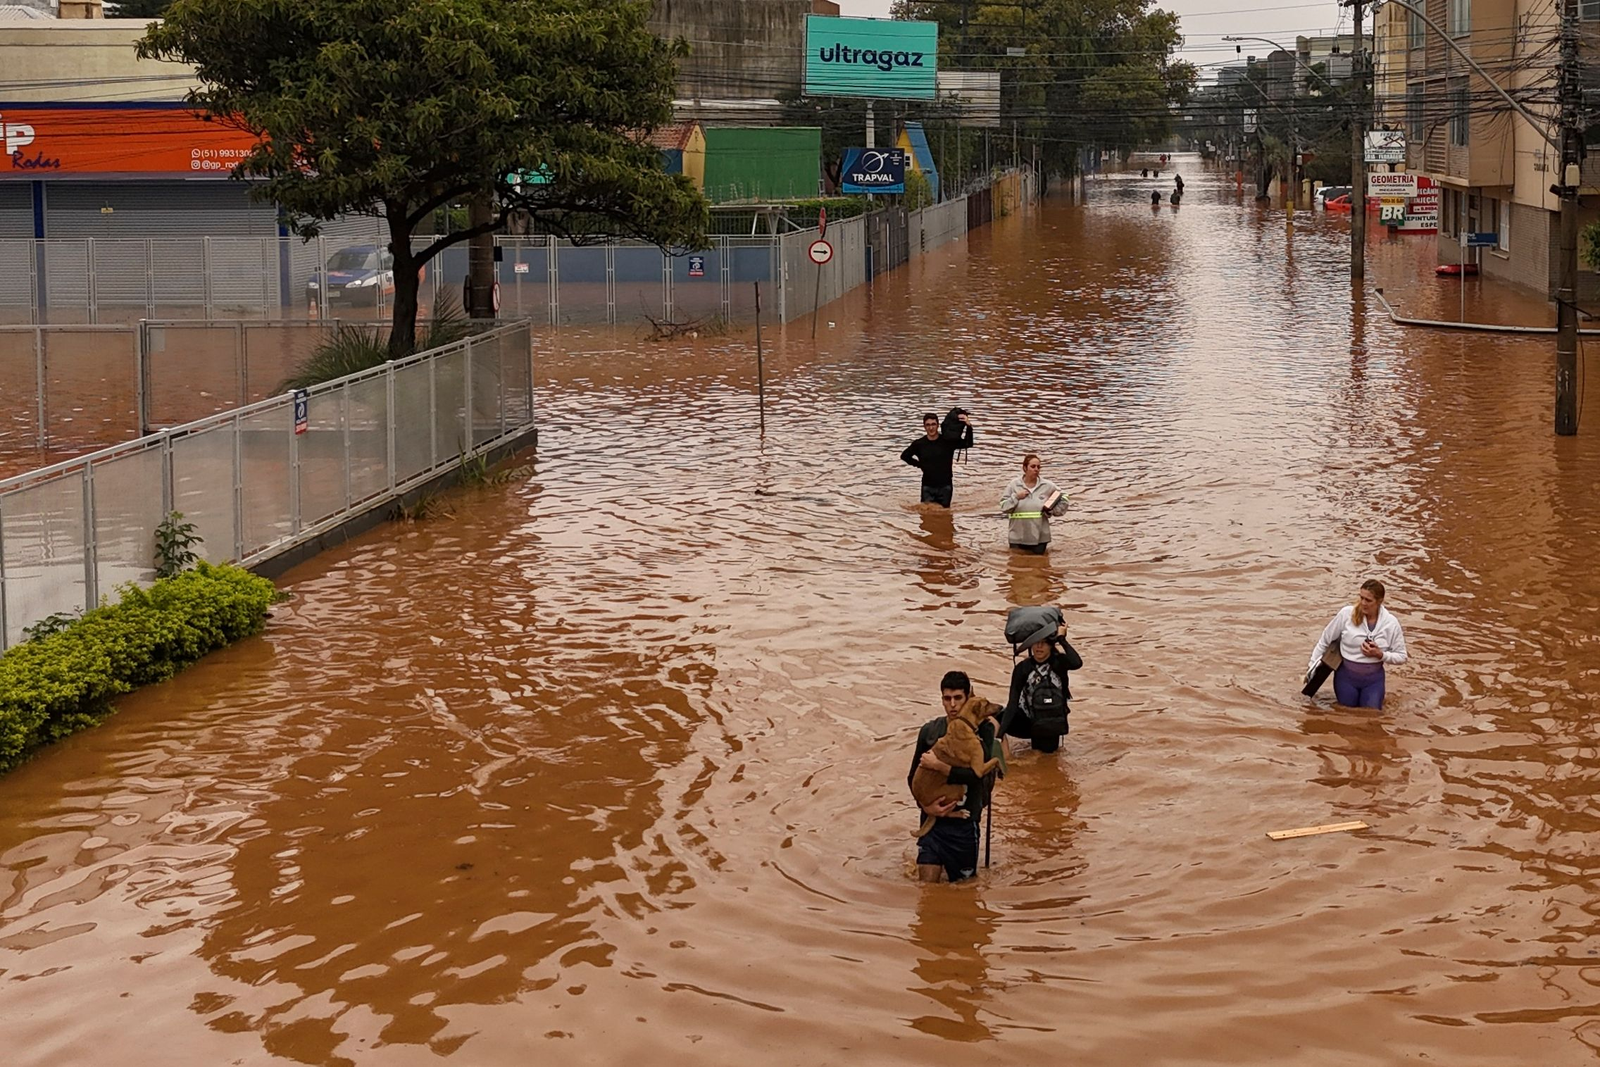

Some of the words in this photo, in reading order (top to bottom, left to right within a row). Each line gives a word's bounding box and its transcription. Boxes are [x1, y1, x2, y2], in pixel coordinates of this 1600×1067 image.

[819, 43, 924, 71] ultragaz
[12, 150, 61, 169] Rodas
[201, 149, 218, 159] (51)
[202, 159, 239, 170] @gp_rod
[852, 173, 895, 182] TRAPVAL
[1371, 175, 1415, 184] GEOMETRIA
[1381, 206, 1404, 220] BR
